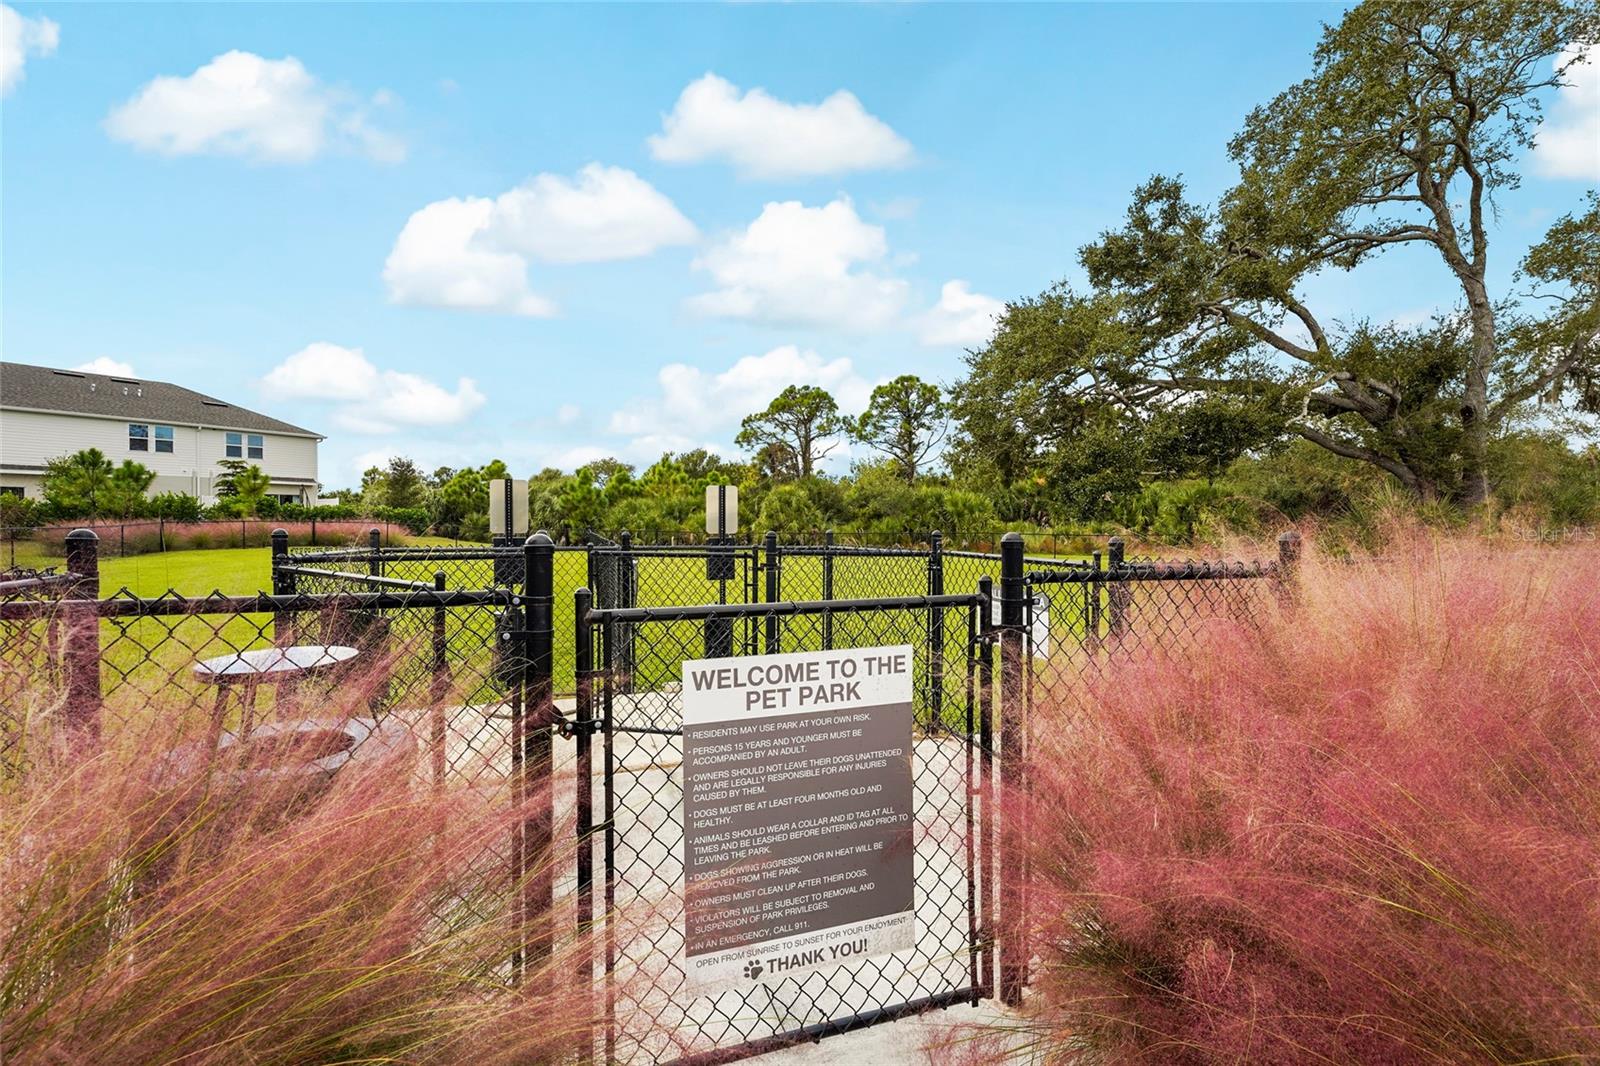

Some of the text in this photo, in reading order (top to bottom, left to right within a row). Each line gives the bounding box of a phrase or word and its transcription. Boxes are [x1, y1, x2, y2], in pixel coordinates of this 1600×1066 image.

[692, 655, 906, 691] WELCOME TO THE
[746, 681, 861, 711] PET PARK
[692, 713, 871, 739] RESIDENTS MAY USE PARK AT YOUR OWN RISK.
[692, 729, 863, 755] PERSONS 15 YEARS AND YOUNGER MUST BE
[692, 745, 807, 766] ACCOMPANIED BY AN ADULT.
[692, 748, 902, 782] OWNERS SHOULD NOT LEAVE THEIR DOGS UNATTENDED
[693, 760, 887, 792] AND ARE LEGALLY RESPONSIBLE FOR ANY INJURIES
[693, 786, 766, 802] CAUSED BY THEM.
[694, 784, 882, 819] DOGS MUST BE AT LEAST FOUR MONTHS OLD AND
[693, 832, 730, 845] ANIMALS
[732, 827, 765, 838] SHOULD
[767, 823, 790, 833] WEAR
[798, 817, 828, 829] COLLAR
[829, 815, 845, 823] AND
[855, 810, 870, 819] TAG
[694, 817, 733, 828] HEALTHY.
[694, 813, 908, 855] TIMES AND BE LEASHED BEFORE ENTERING AND PRIOR TO
[694, 846, 771, 866] LEAVING THE PARK.
[694, 871, 719, 881] DOGS
[721, 864, 759, 877] SHOWING
[761, 854, 811, 869] AGGRESSION
[813, 852, 824, 860] OR
[826, 850, 834, 858] IN
[835, 847, 854, 857] HEAT
[855, 844, 872, 853] WILL
[694, 895, 731, 907] OWNERS
[733, 890, 756, 901] MUST
[757, 885, 783, 896] CLEAN
[797, 878, 821, 889] AFTER
[822, 873, 844, 884] THEIR
[846, 869, 868, 879] DOGS.
[736, 874, 760, 884] FROM
[762, 871, 777, 879] THE
[779, 867, 802, 877] PARK.
[695, 882, 875, 924] VIOLATORS WILL BE SUBJECT TO REMOVAL AND
[695, 901, 829, 934] SUSPENSION OF PARK PRIVILEGES.
[695, 921, 809, 950] IN AN EMERGENCY, CALL 911.
[696, 958, 720, 968] OPEN
[721, 952, 745, 963] FROM
[746, 943, 780, 958] SUNRISE
[783, 941, 793, 949] TO
[794, 935, 824, 947] SUNSET
[826, 931, 841, 940] FOR
[842, 926, 863, 937] YOUR
[766, 939, 868, 973] THANK YOU!
